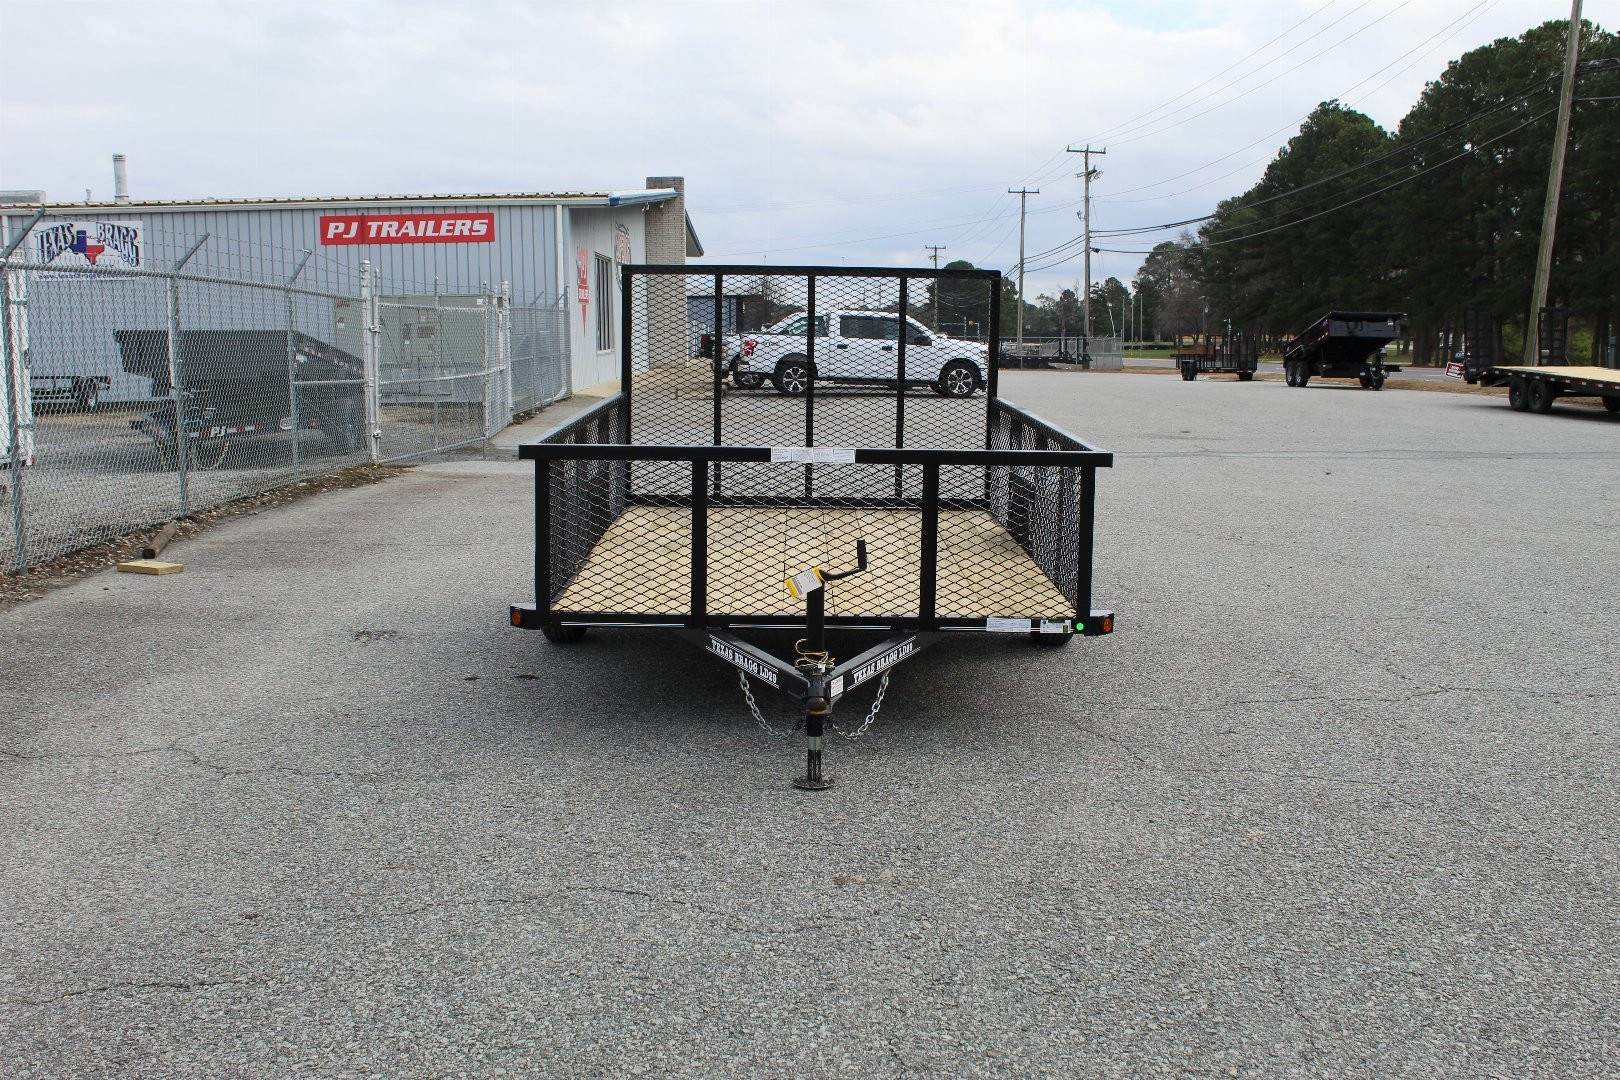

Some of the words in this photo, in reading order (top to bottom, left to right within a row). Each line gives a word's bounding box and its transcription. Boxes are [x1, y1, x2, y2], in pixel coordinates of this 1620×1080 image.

[34, 222, 74, 265] TEXAS
[96, 221, 140, 268] BRAGG
[327, 222, 359, 239] PJ
[367, 219, 489, 238] TRAILERS
[711, 639, 733, 660] TEXAS
[734, 651, 758, 674] BRAGG
[853, 662, 875, 685] TEXAS
[876, 649, 898, 671] BRAGG
